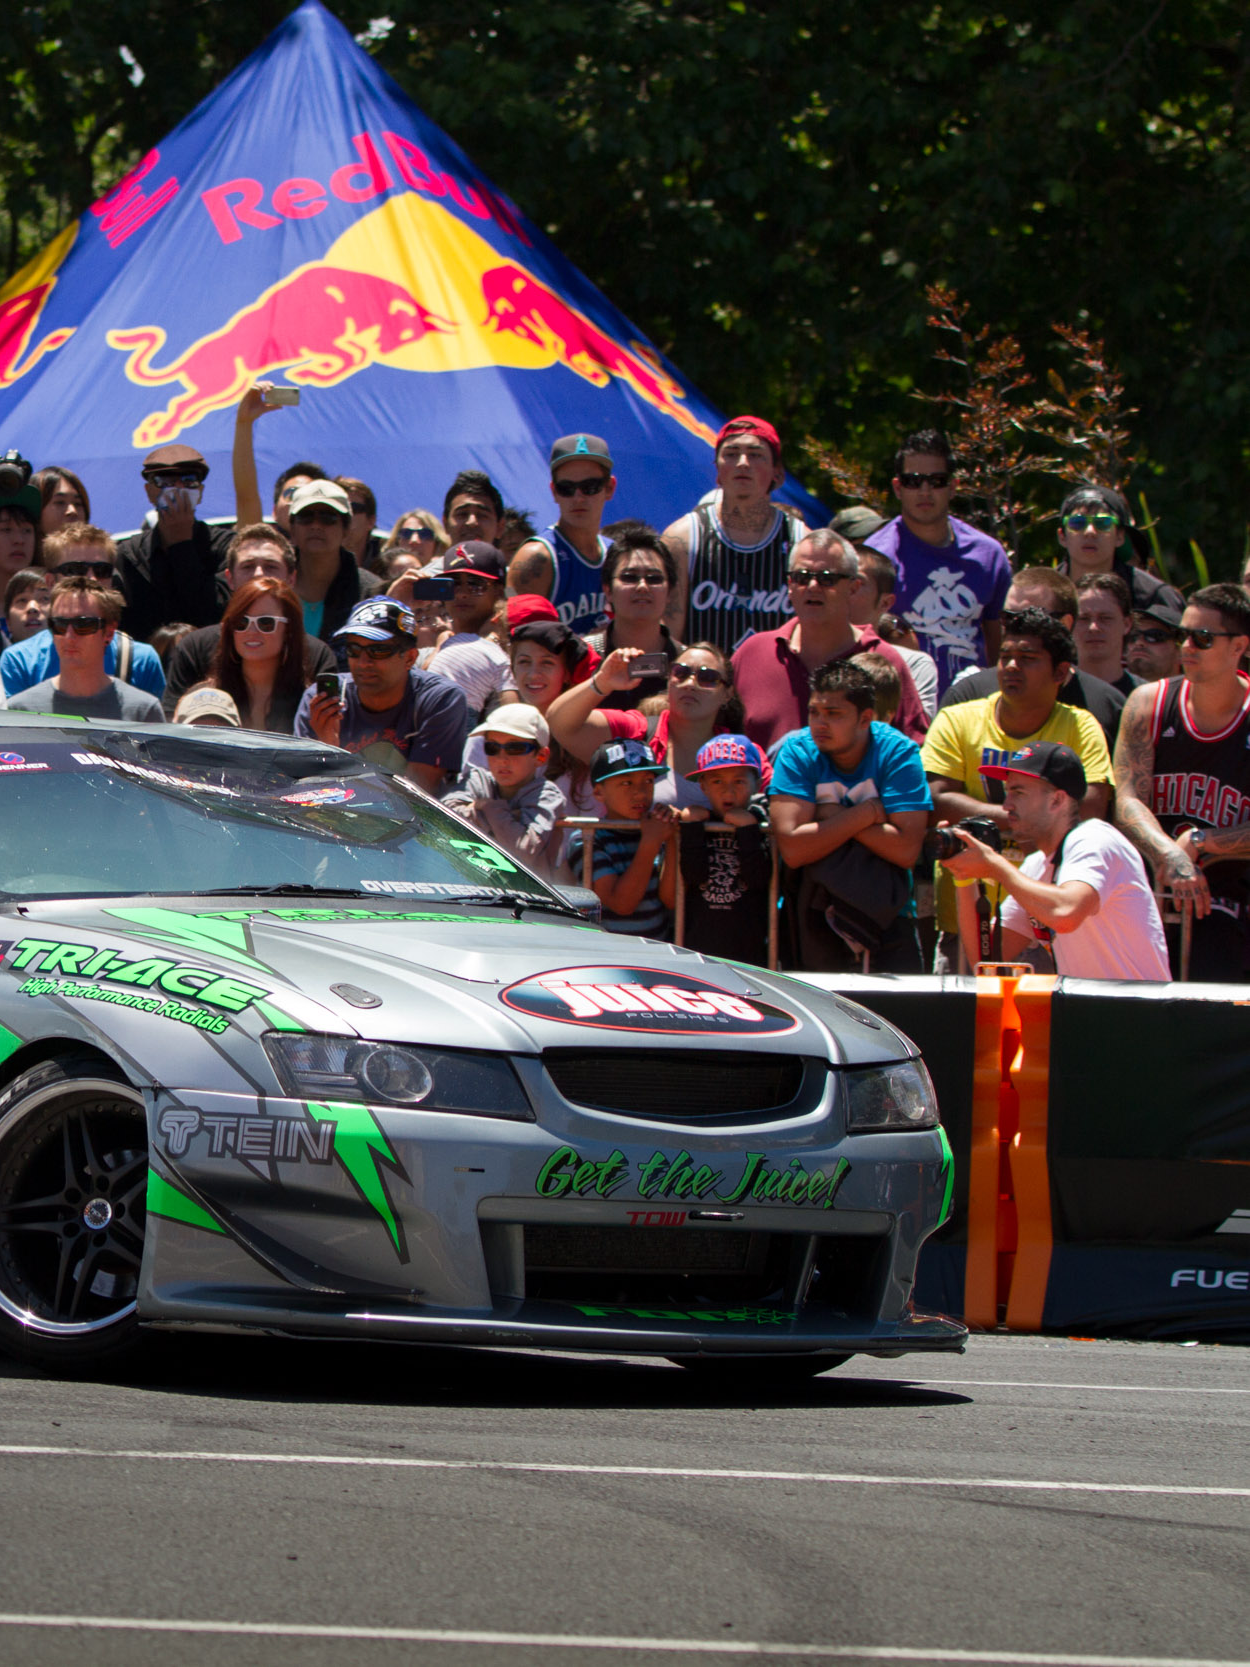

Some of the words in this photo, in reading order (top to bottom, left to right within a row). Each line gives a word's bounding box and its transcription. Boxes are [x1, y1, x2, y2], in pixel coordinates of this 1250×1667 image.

[201, 131, 394, 245] Red
[381, 131, 534, 249] Bull
[557, 593, 607, 627] DALL
[1152, 772, 1250, 829] HICAGO
[450, 840, 517, 873] 3
[9, 938, 273, 1013] TRI-ACE
[18, 978, 56, 997] High
[53, 980, 160, 1013] Performance
[157, 998, 230, 1035] Radials
[538, 979, 765, 1022] juice
[625, 1012, 730, 1023] POLISHES
[203, 1115, 333, 1161] TEIN
[535, 1145, 630, 1198] Get
[637, 1149, 723, 1199] the
[713, 1152, 851, 1209] Juice!
[626, 1211, 687, 1226] TOW
